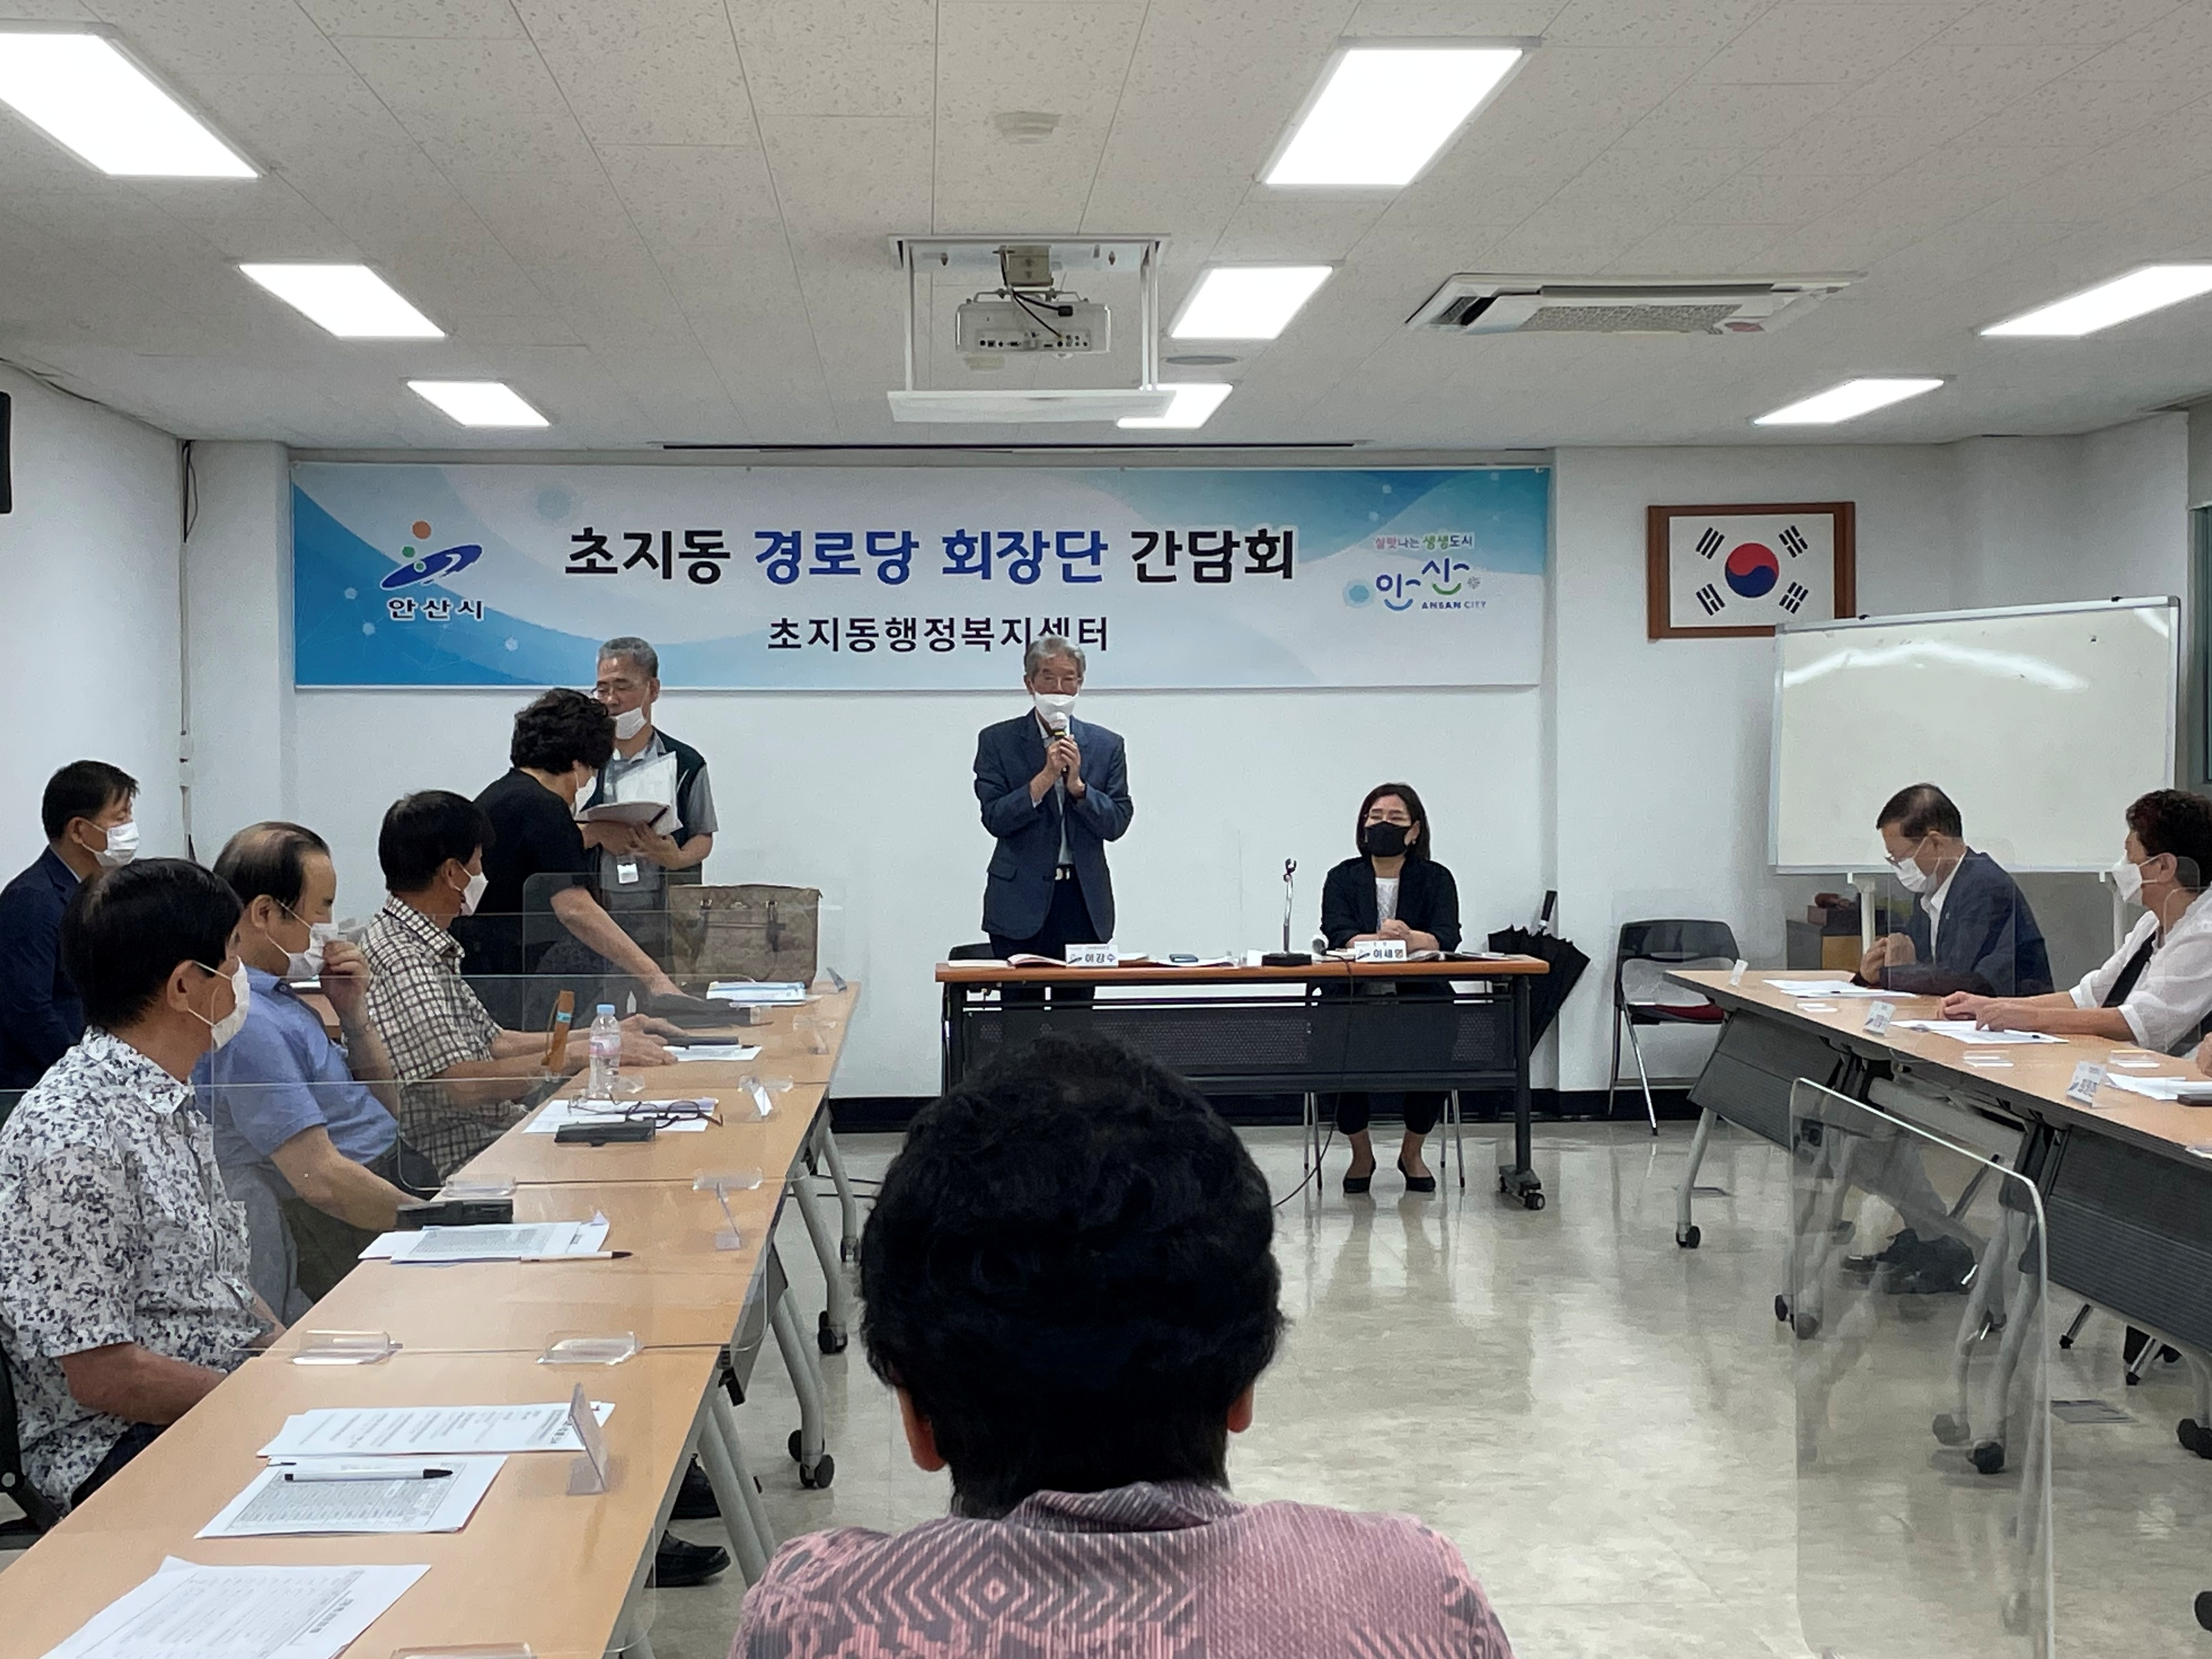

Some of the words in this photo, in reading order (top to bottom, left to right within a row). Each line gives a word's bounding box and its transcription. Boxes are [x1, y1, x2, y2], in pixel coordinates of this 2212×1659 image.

[1422, 534, 1473, 550] 생생도시
[565, 526, 731, 585] 초지동
[754, 530, 920, 586] 경로당
[941, 528, 1109, 585] 회장단
[1131, 528, 1294, 584] 간담회
[388, 599, 482, 620] 안산시
[1421, 601, 1461, 610] ANSAN
[1463, 601, 1487, 610] CITY
